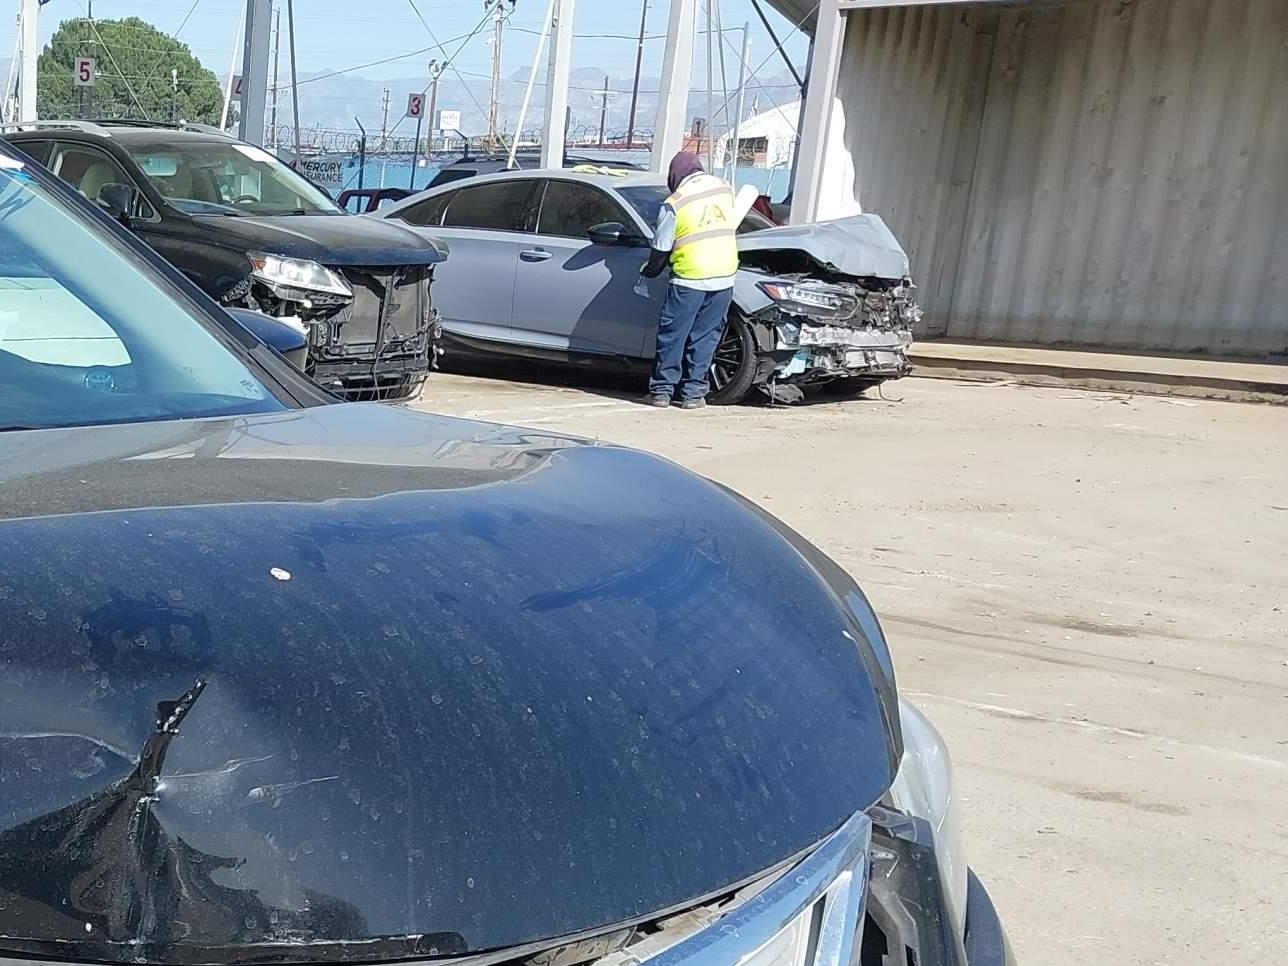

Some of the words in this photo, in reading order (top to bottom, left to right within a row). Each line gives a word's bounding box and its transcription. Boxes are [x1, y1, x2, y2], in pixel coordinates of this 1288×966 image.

[79, 61, 90, 82] 5
[411, 96, 421, 115] 3
[693, 120, 701, 137] 1
[299, 160, 343, 173] MERCURY
[300, 170, 343, 182] NSURANCE
